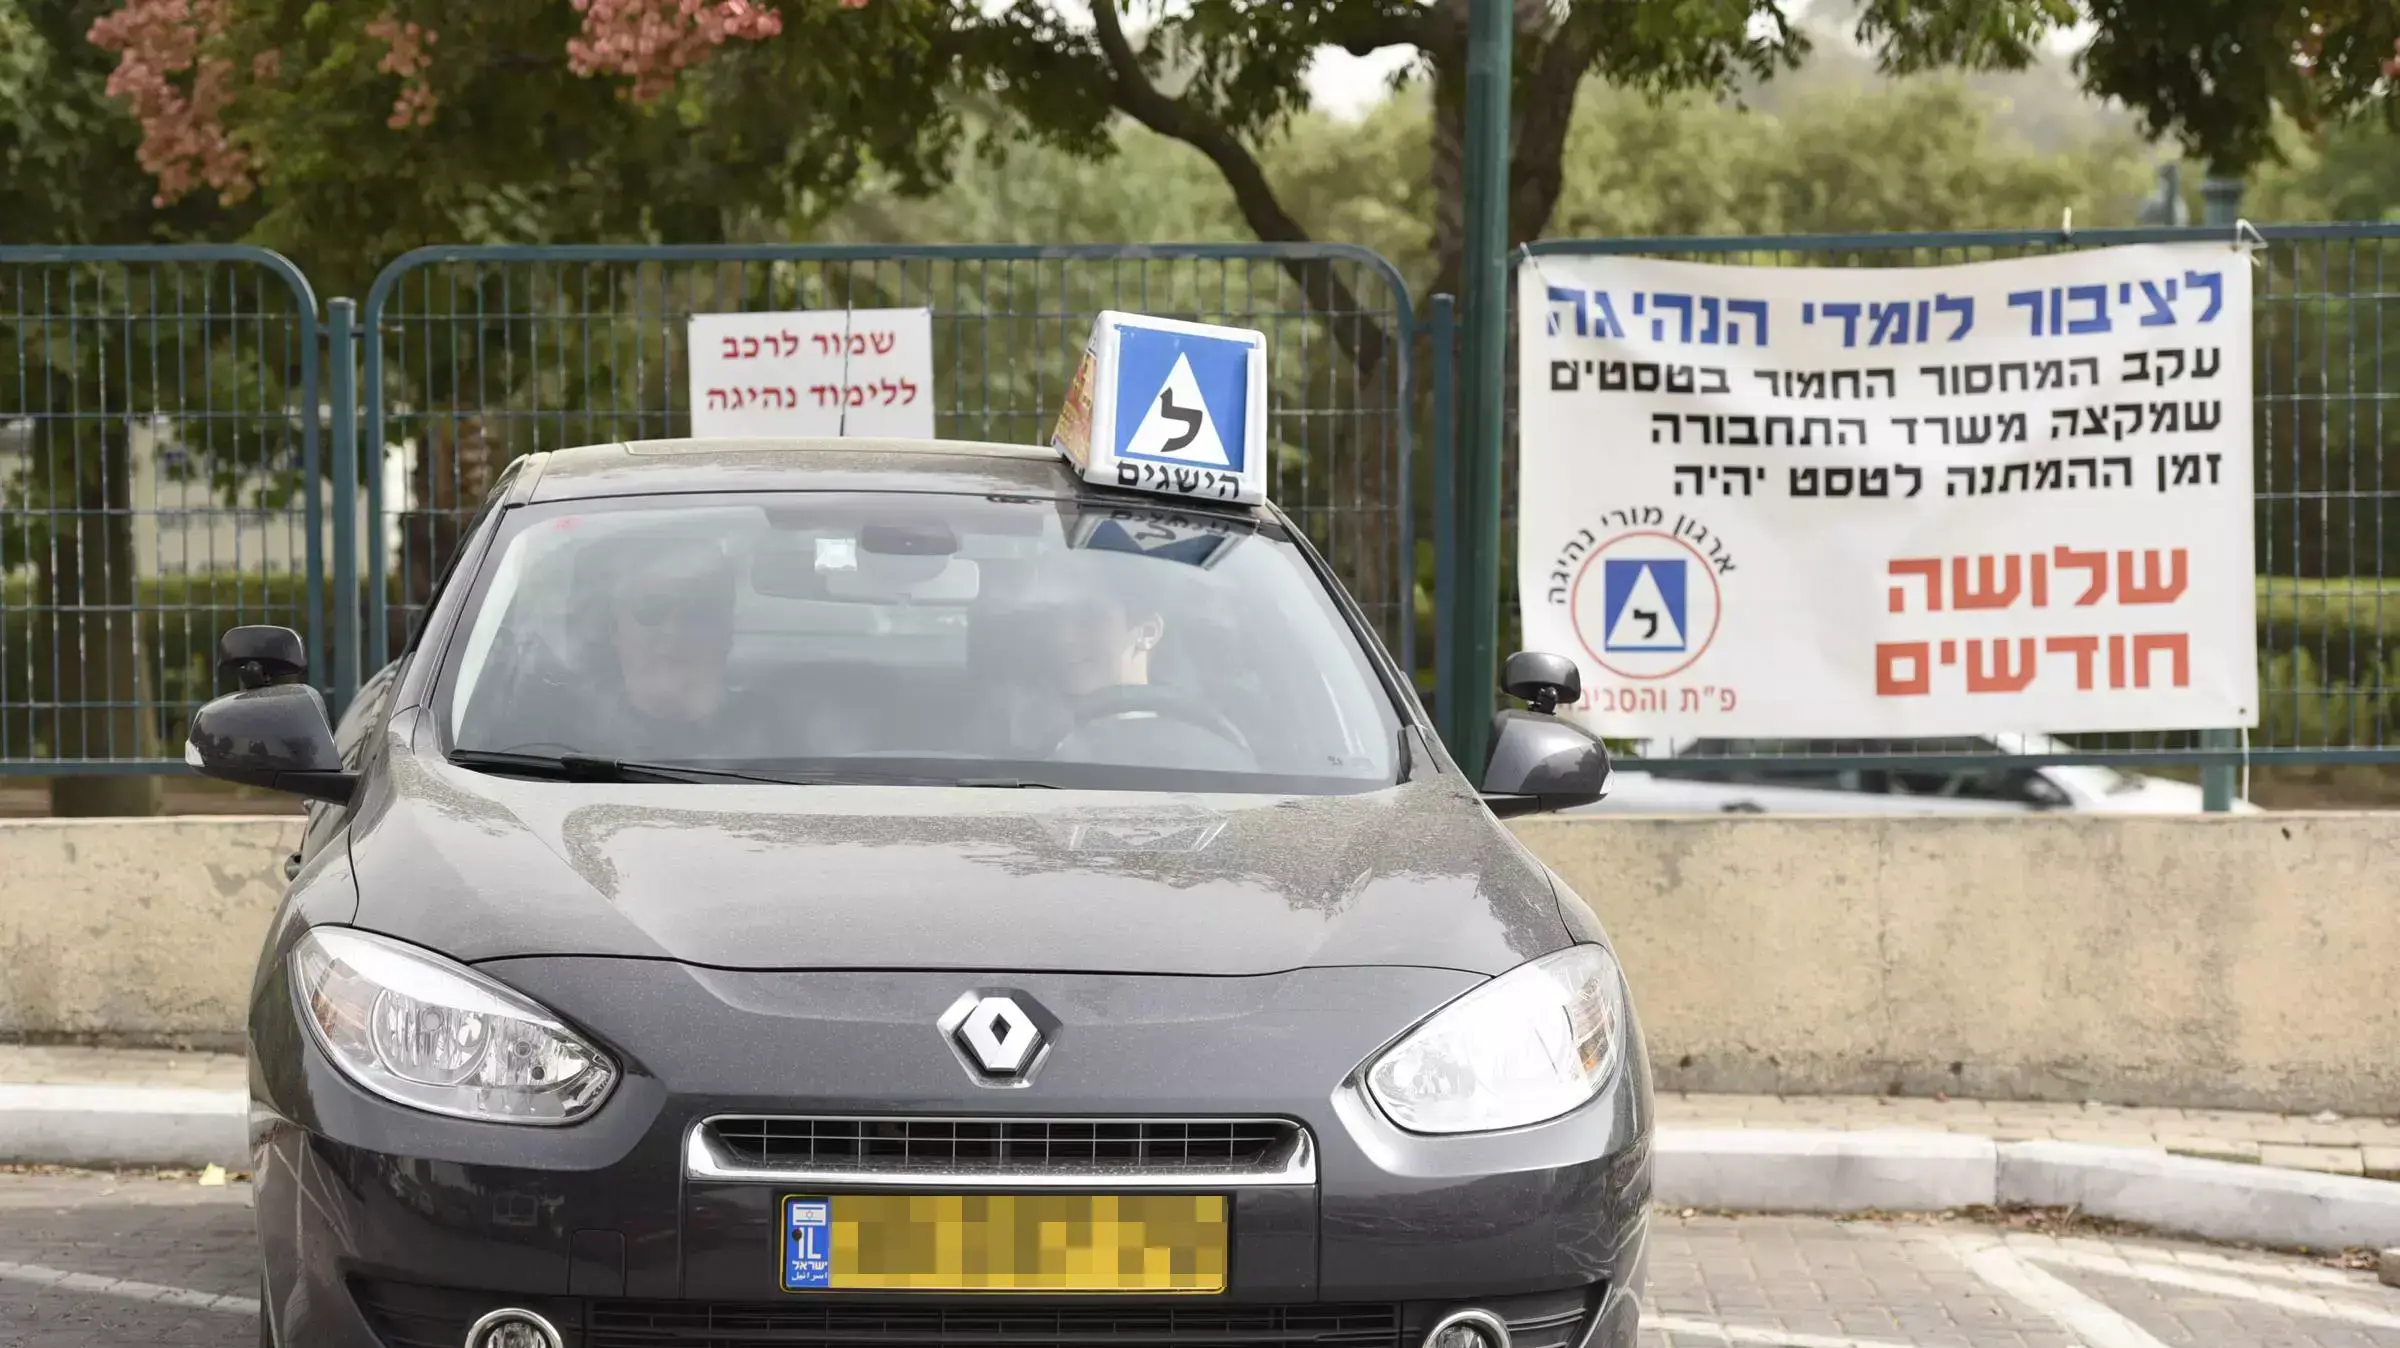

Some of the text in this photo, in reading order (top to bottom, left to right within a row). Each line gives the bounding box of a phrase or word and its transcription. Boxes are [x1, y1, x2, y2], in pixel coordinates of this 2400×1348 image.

[1547, 271, 2222, 347] לציבור לומדי הנהיגה
[721, 330, 896, 359] שמור לרכב
[706, 377, 918, 411] ללימוד נהיגה
[1550, 348, 2220, 398] עקב המחסור החמור בטסטים
[1160, 387, 1203, 452] ל
[1652, 401, 2221, 446] שמקצה משרד התחבורה
[1117, 461, 1239, 498] הישגים
[1674, 454, 2221, 497] זמן ההמתנה לטסט יהיה
[1548, 506, 1737, 604] ארגון מורי נהיגה
[1888, 546, 2188, 613] שלושה
[1633, 608, 1659, 640] ל
[1876, 633, 2189, 695] חודשים
[1558, 687, 1667, 713] והסביב
[798, 1227, 822, 1259] IL
[791, 1260, 828, 1271] ישראל
